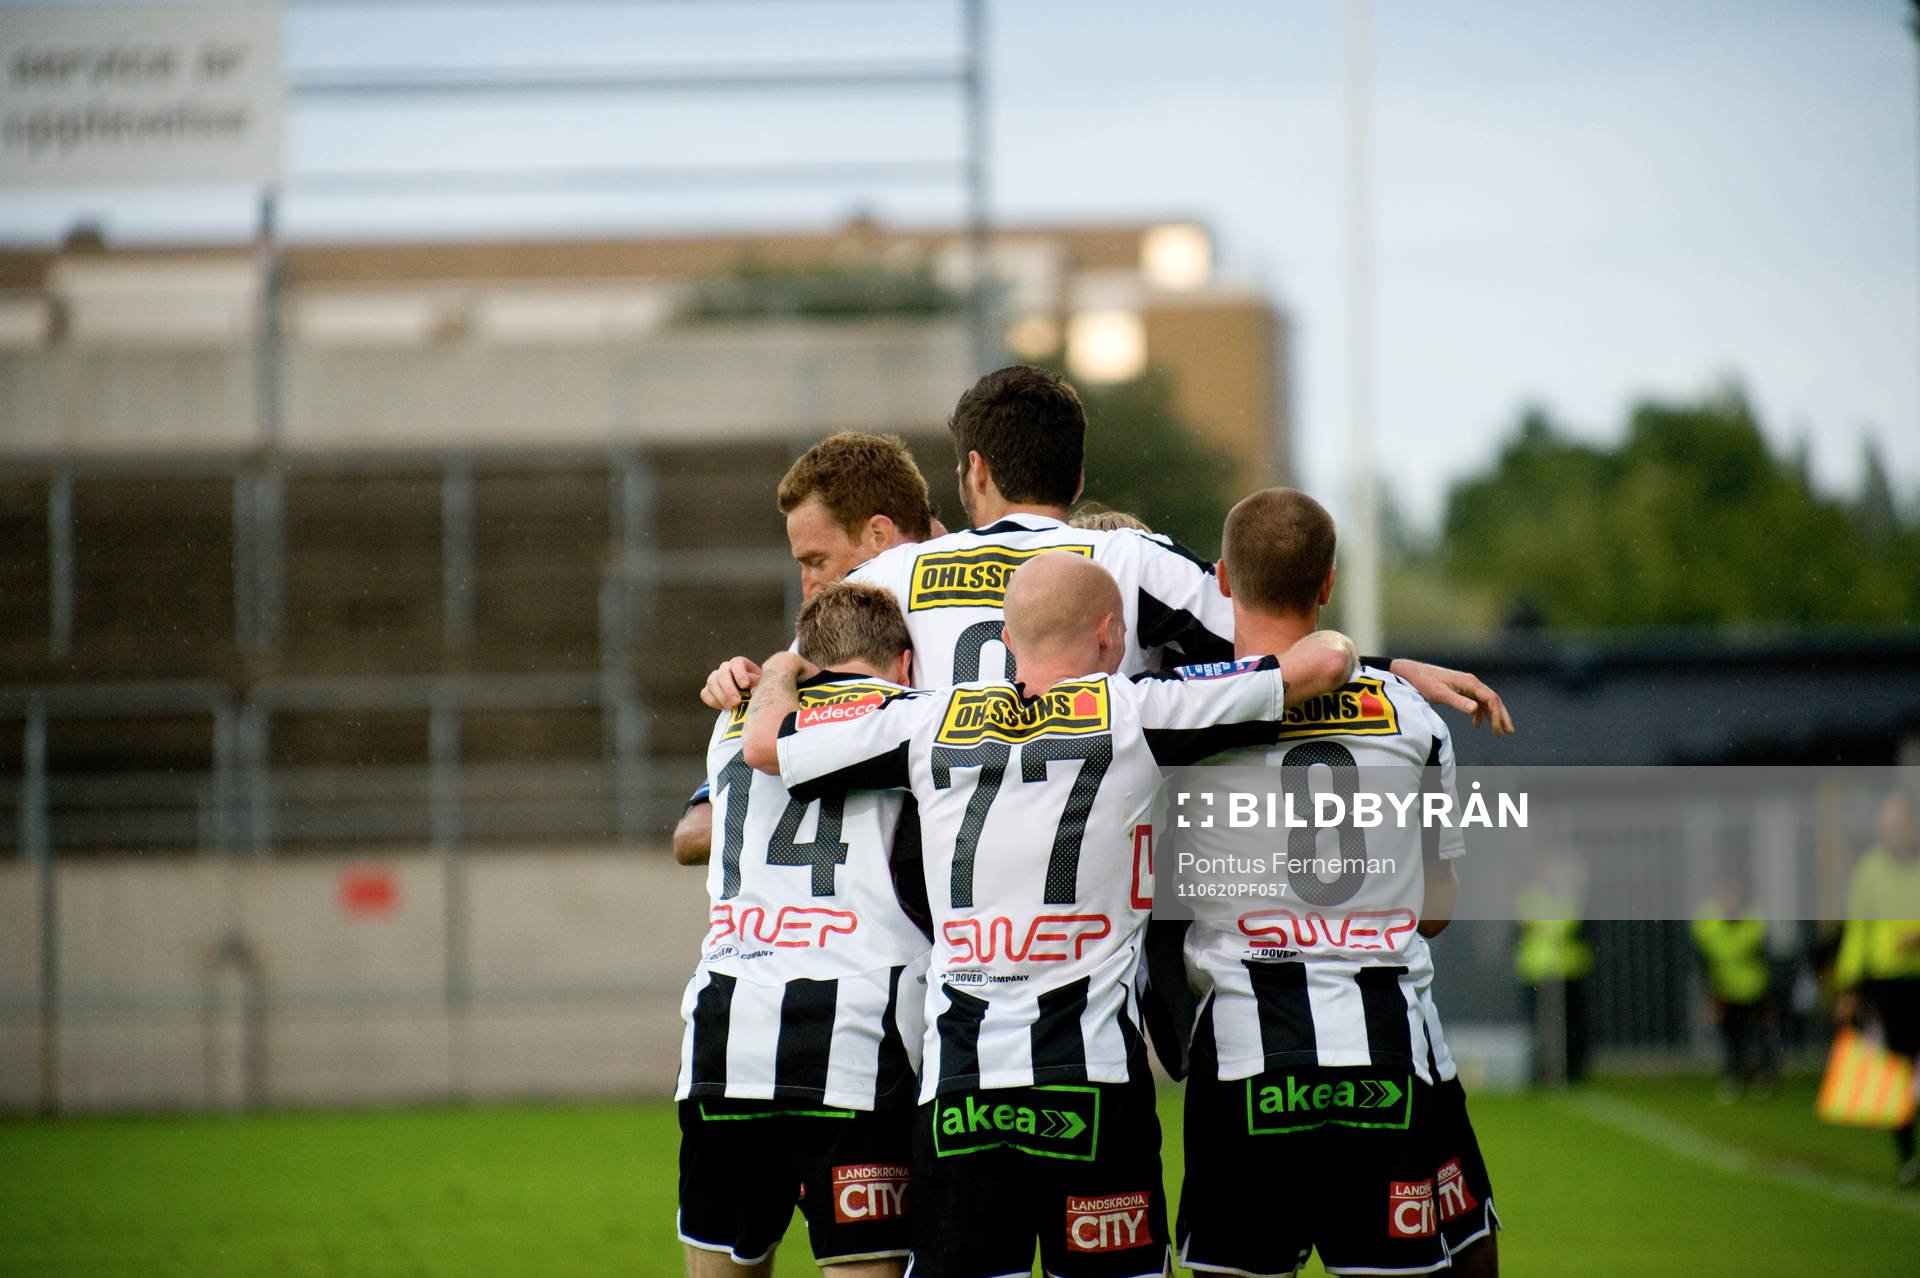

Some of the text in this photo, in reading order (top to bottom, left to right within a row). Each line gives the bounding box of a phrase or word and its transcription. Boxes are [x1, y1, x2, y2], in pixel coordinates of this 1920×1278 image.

[804, 703, 877, 724] Adecco
[717, 748, 849, 900] 14
[931, 733, 1114, 909] 77
[1280, 741, 1367, 907] 8
[943, 914, 1111, 964] SWEP
[955, 973, 983, 983] DOVER
[988, 974, 1030, 983] COMPANY
[1259, 1075, 1355, 1114] akea
[943, 1096, 1036, 1135] akea
[838, 1166, 910, 1181] LANDSKRONA
[839, 1182, 909, 1218] CITY
[1071, 1195, 1146, 1211] LANDSKRONA
[1071, 1210, 1145, 1249] CITY
